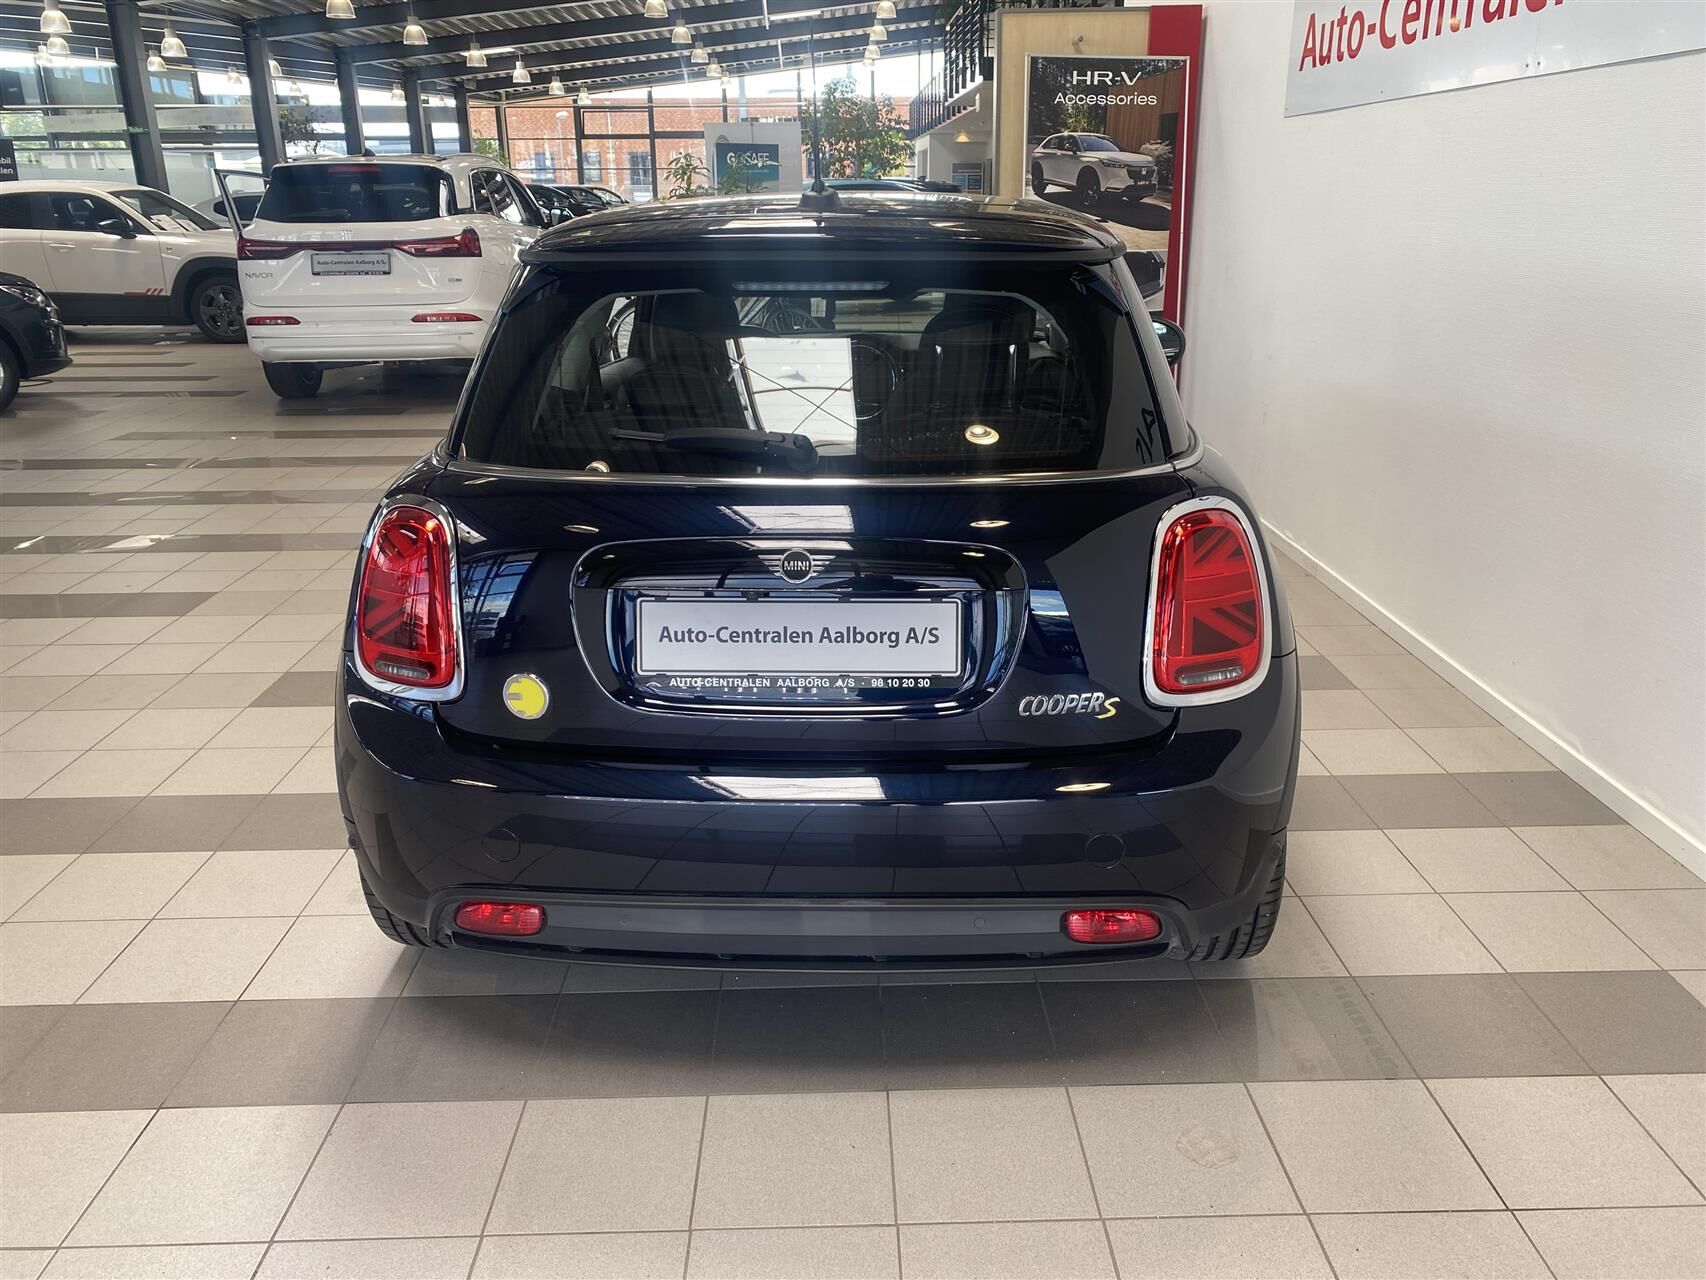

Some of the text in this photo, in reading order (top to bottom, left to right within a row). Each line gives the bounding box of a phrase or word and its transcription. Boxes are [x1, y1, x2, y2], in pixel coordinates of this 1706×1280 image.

[1298, 0, 1564, 72] Auto-Centr
[1072, 70, 1142, 86] HR-V
[1054, 92, 1157, 105] Accessories
[0, 156, 11, 164] bil
[783, 560, 810, 571] MINI
[658, 625, 941, 649] Auto-Centralen Aalborg A/S
[669, 678, 931, 688] AUTO-CENTRALEN AALBORG A/S 98 10 20 30
